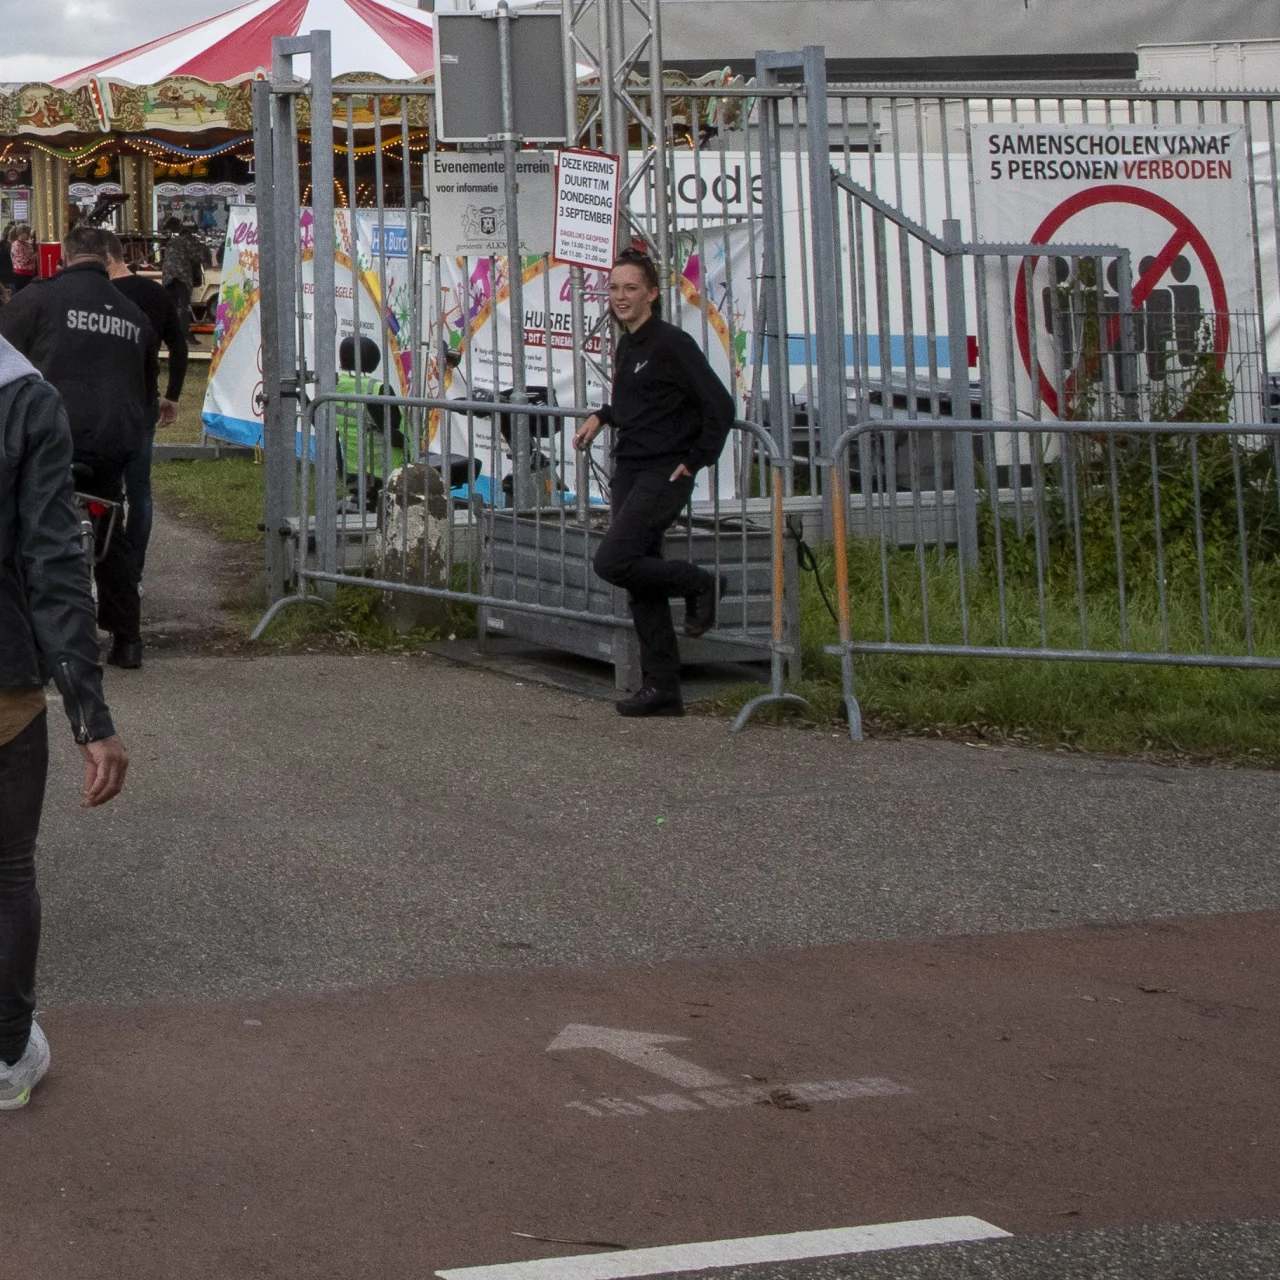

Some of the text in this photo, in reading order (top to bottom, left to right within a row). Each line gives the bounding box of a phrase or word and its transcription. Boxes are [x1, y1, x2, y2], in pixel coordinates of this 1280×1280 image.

[988, 134, 1231, 155] SAMENSCHOLEN VANAF
[433, 159, 550, 174] Evenementeerrein
[562, 157, 614, 175] DEZE KERMIS
[991, 160, 1233, 180] 5 PERSONEN VERBODEN
[436, 182, 499, 193] voor informatie
[564, 174, 609, 191] DUURT T/M
[560, 190, 613, 208] DONDERDAG
[559, 206, 612, 225] 3 SEPTEMBER
[486, 241, 529, 251] ALKMR
[66, 310, 141, 343] SECURITY
